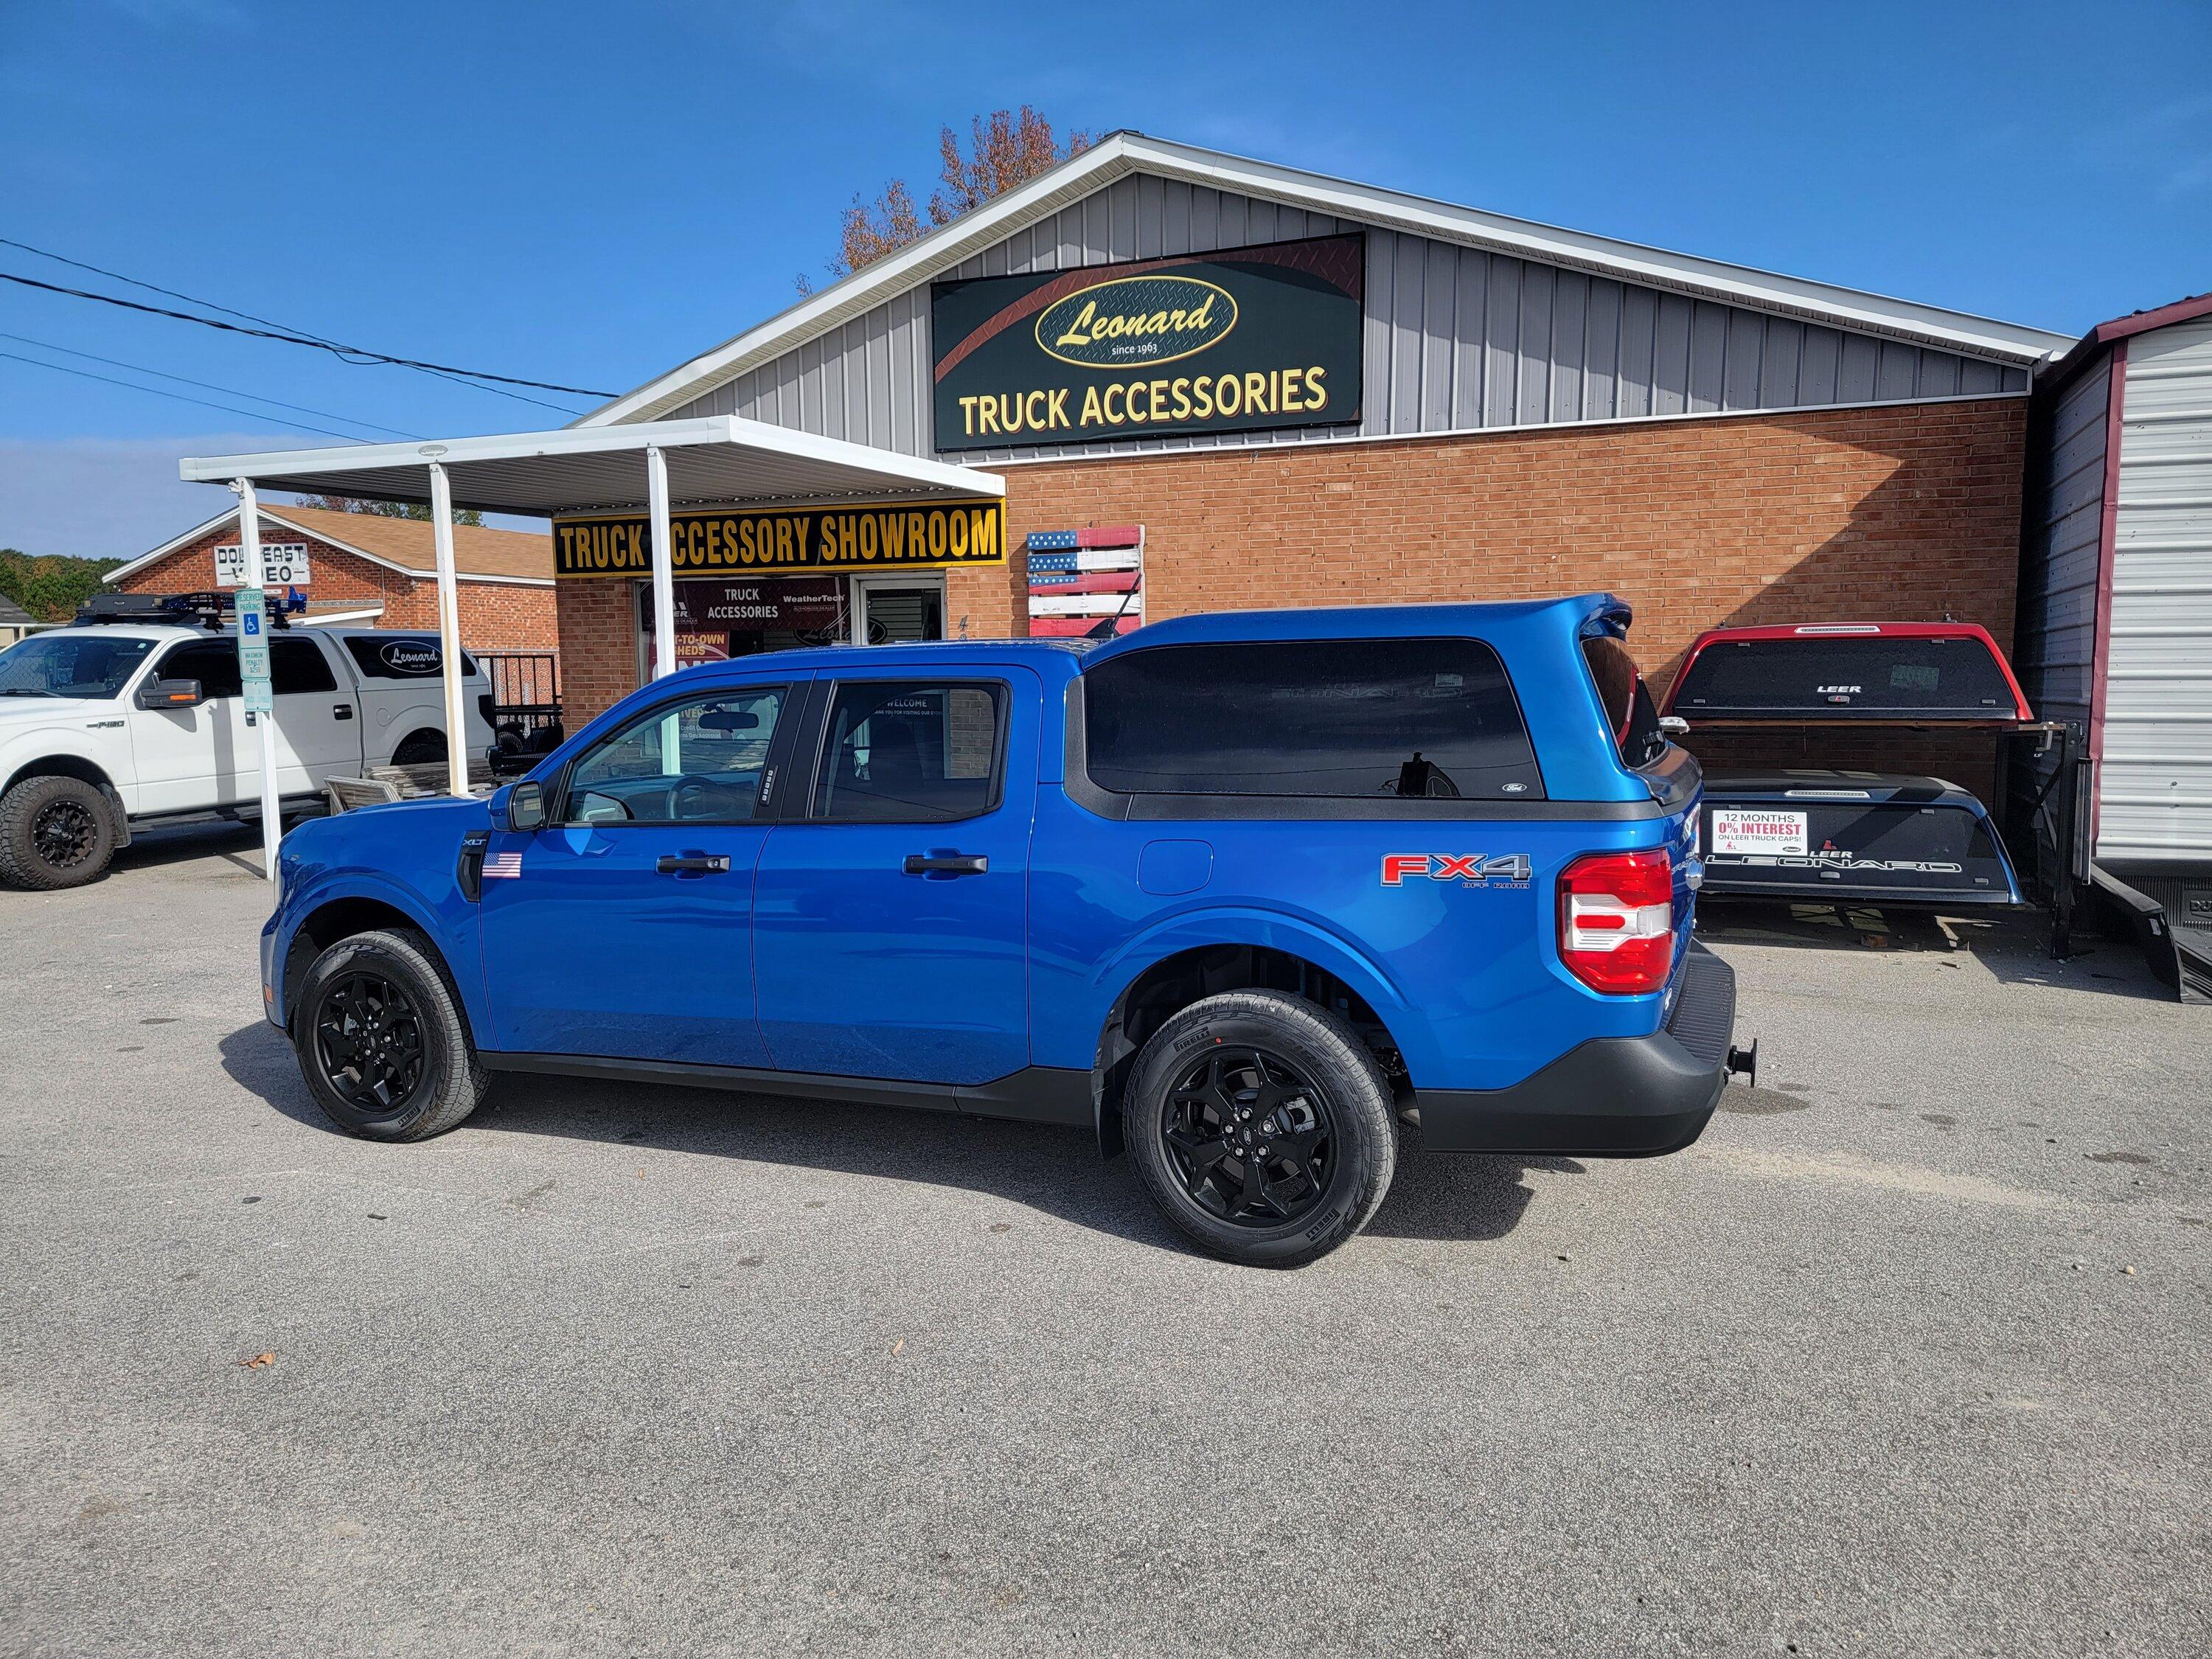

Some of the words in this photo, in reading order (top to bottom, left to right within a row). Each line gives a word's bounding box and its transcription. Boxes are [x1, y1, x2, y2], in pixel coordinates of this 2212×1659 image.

[1057, 293, 1215, 347] Leonard
[1111, 345, 1135, 355] since
[1138, 343, 1158, 354] 1963
[959, 388, 1072, 437] TRUCK
[1079, 365, 1329, 428] ACCESSORIES
[560, 524, 645, 568] TRUCK
[671, 518, 810, 565] CCESSORY
[821, 508, 998, 560] SHOWROOM
[725, 589, 759, 601] TRUCK
[783, 594, 845, 603] WeatherTech
[708, 605, 778, 619] ACCESSORIES
[391, 648, 438, 664] Leonard
[1741, 814, 1795, 823] MONTHS
[1719, 822, 1738, 834] 0%
[1742, 823, 1801, 835] INTEREST
[1380, 853, 1532, 887] FX4
[1705, 855, 1962, 873] LEONARD
[1172, 1026, 1211, 1052] PIRELLI
[1304, 1208, 1340, 1242] PIRELLI
